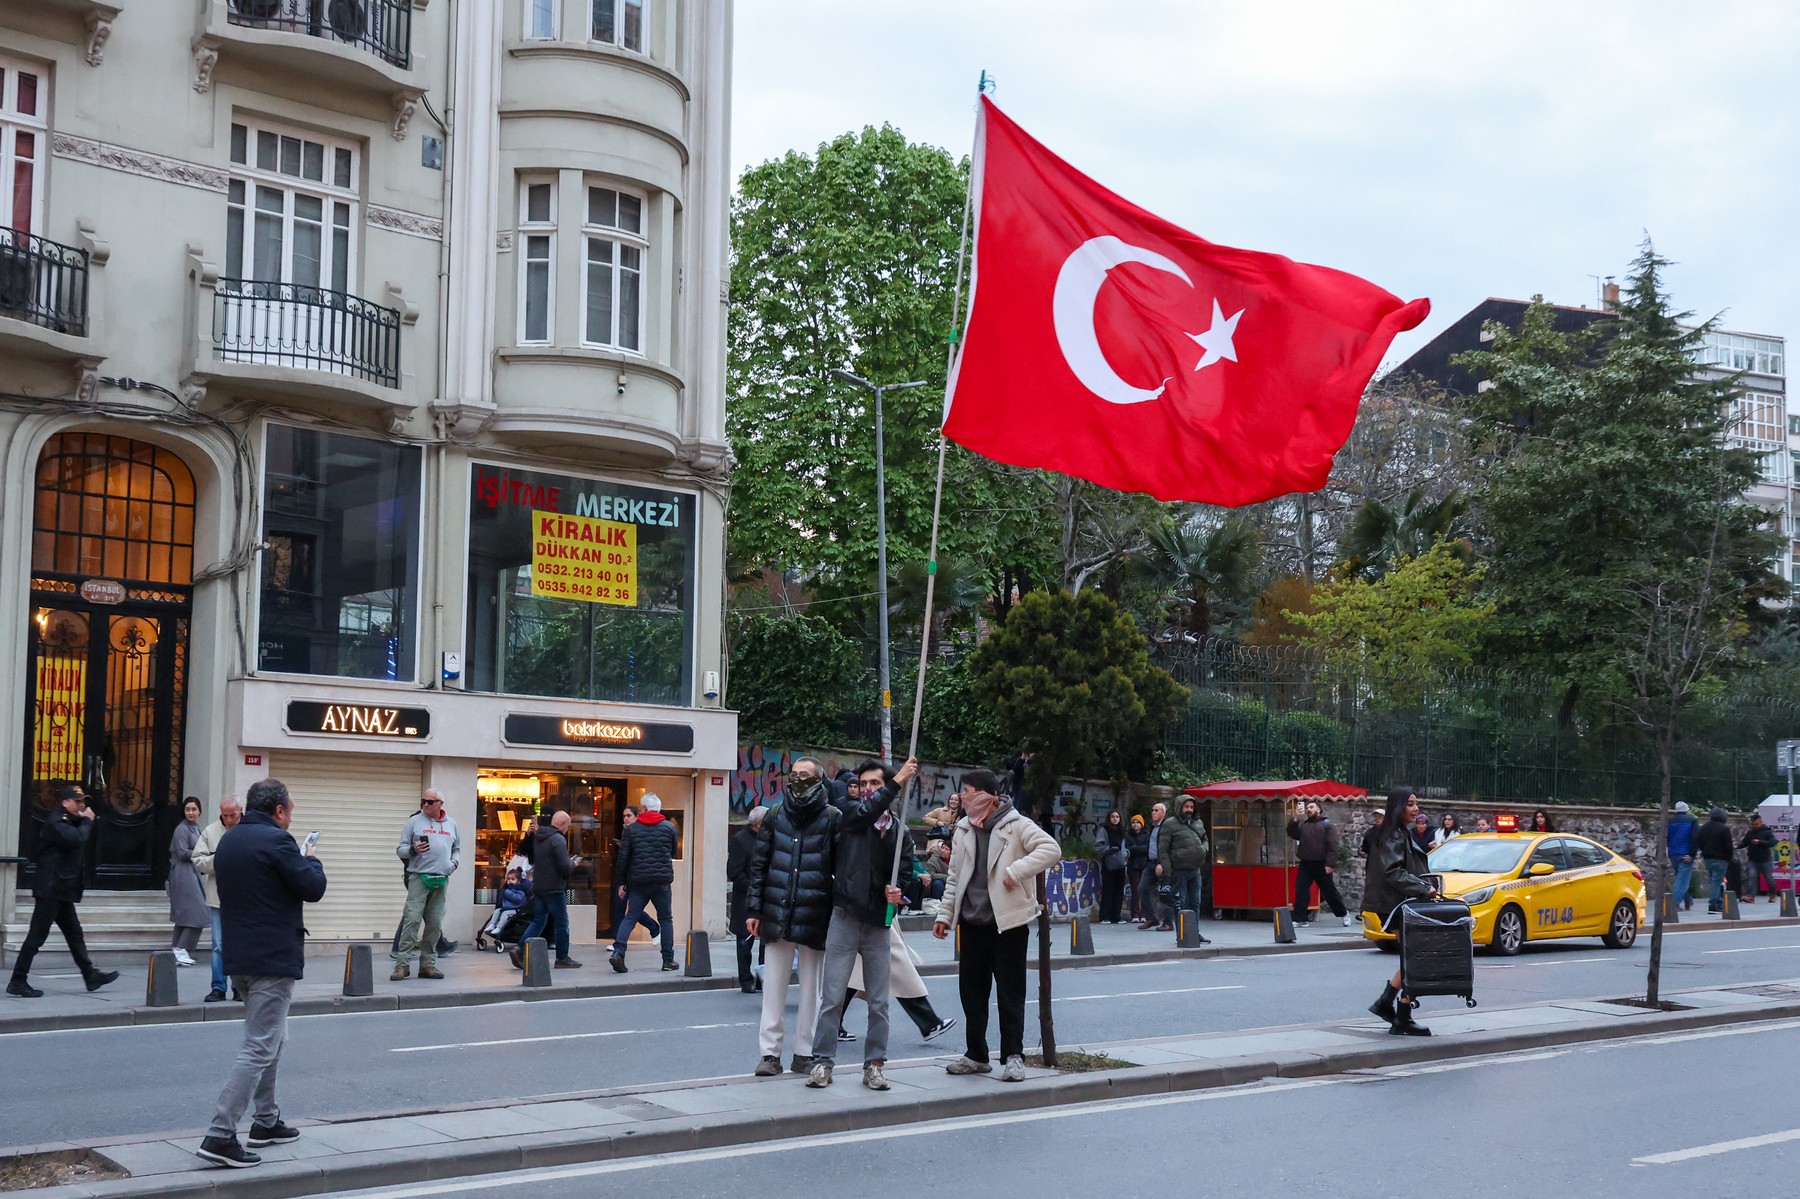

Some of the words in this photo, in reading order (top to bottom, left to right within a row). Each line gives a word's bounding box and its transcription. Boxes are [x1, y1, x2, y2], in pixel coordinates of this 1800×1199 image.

[477, 468, 560, 513] İŞİTME
[575, 492, 680, 528] MERKEZİ
[540, 516, 628, 548] KİRALIK
[536, 540, 602, 564] DÜKKAN
[573, 566, 593, 580] 213
[596, 568, 611, 582] 40
[616, 571, 629, 584] 01
[571, 583, 592, 596] 942
[596, 586, 610, 598] 82
[614, 588, 630, 600] 36
[321, 705, 400, 735] AYNAZ
[1537, 908, 1558, 926] TFU
[1560, 906, 1574, 924] 48
